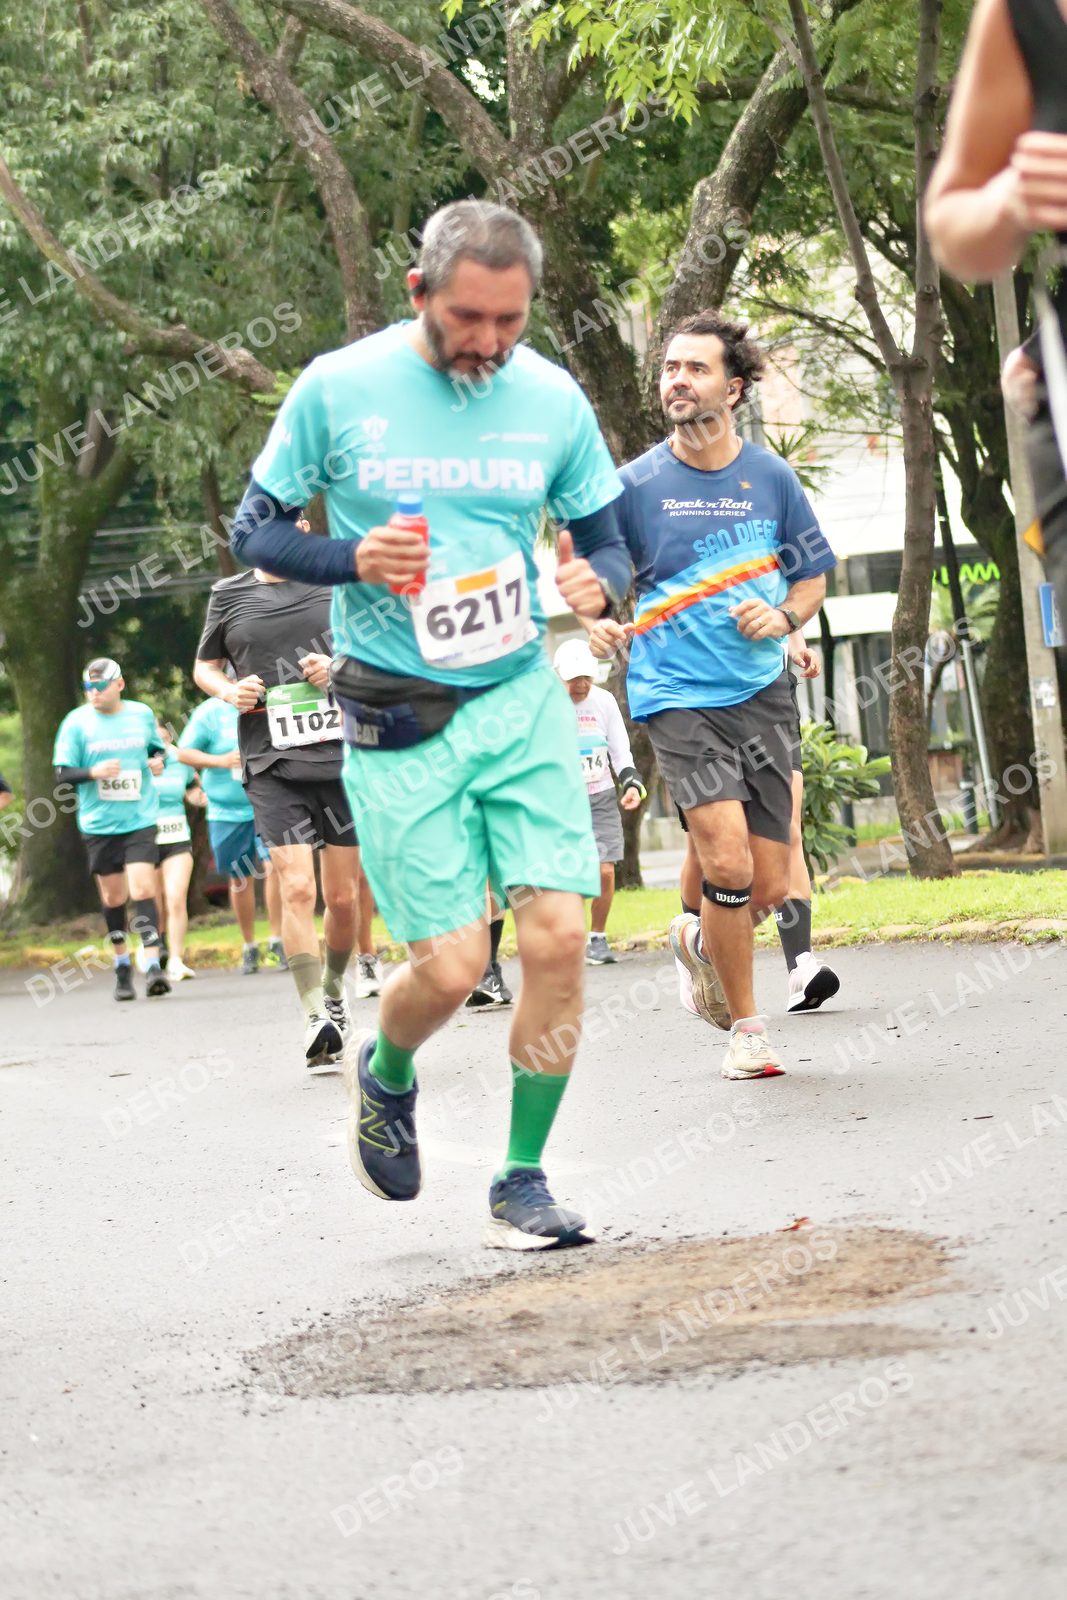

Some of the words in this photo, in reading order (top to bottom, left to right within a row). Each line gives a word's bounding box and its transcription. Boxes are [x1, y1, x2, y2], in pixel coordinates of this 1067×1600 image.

[358, 458, 545, 491] PERDURA
[692, 528, 734, 560] SAN
[426, 577, 521, 640] 6217
[276, 709, 341, 737] 1102
[715, 892, 751, 904] Wilson
